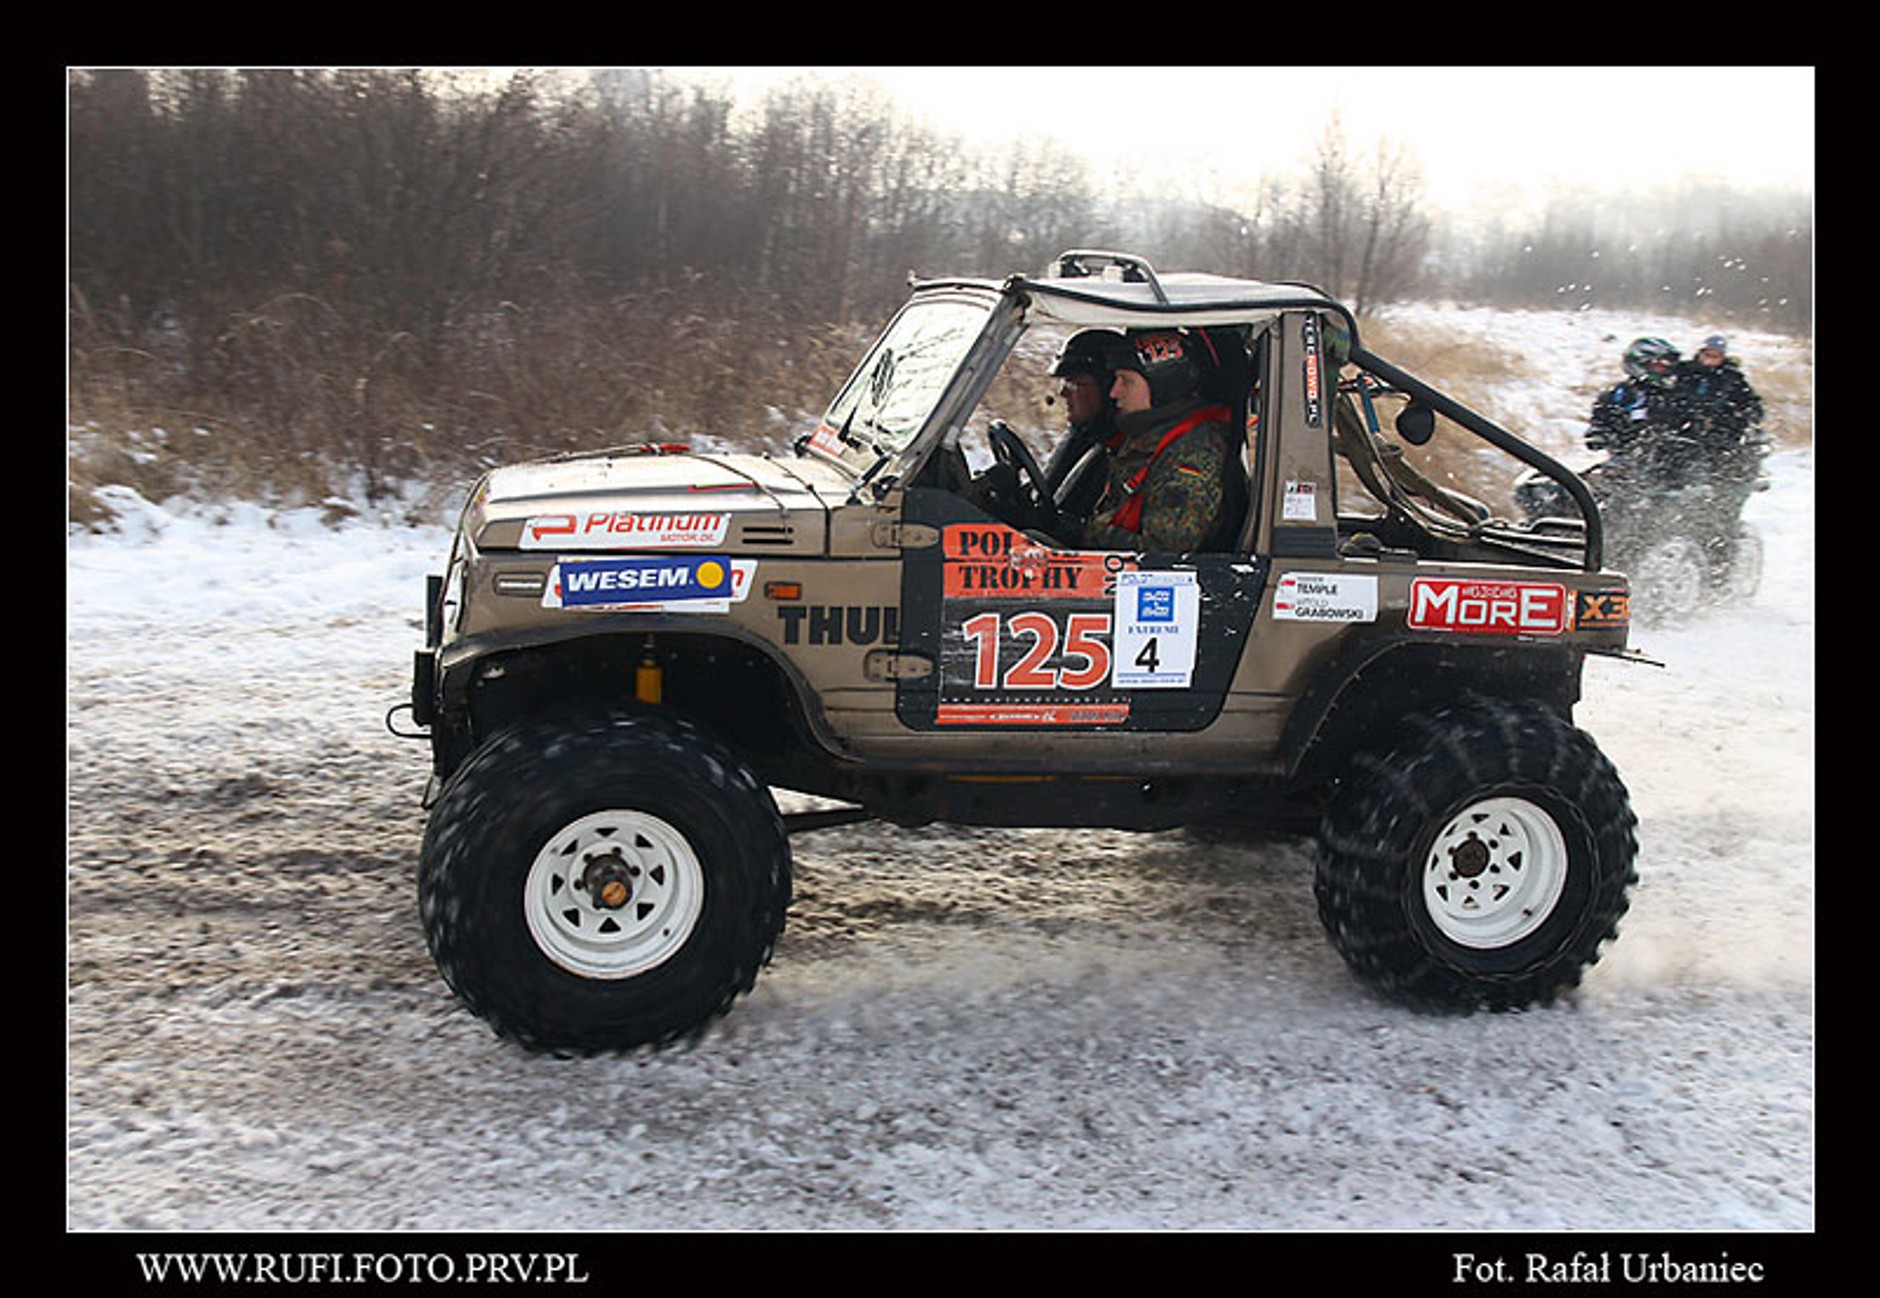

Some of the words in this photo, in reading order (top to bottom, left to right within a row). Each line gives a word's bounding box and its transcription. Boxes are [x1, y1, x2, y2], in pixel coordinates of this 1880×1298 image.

[583, 512, 721, 533] Platinum
[567, 567, 690, 592] WESEM
[1297, 584, 1338, 595] TEMPLE
[778, 606, 901, 645] THUL
[1295, 607, 1364, 619] GRABOWSKI
[963, 612, 1111, 690] 125
[1135, 637, 1159, 673] 4
